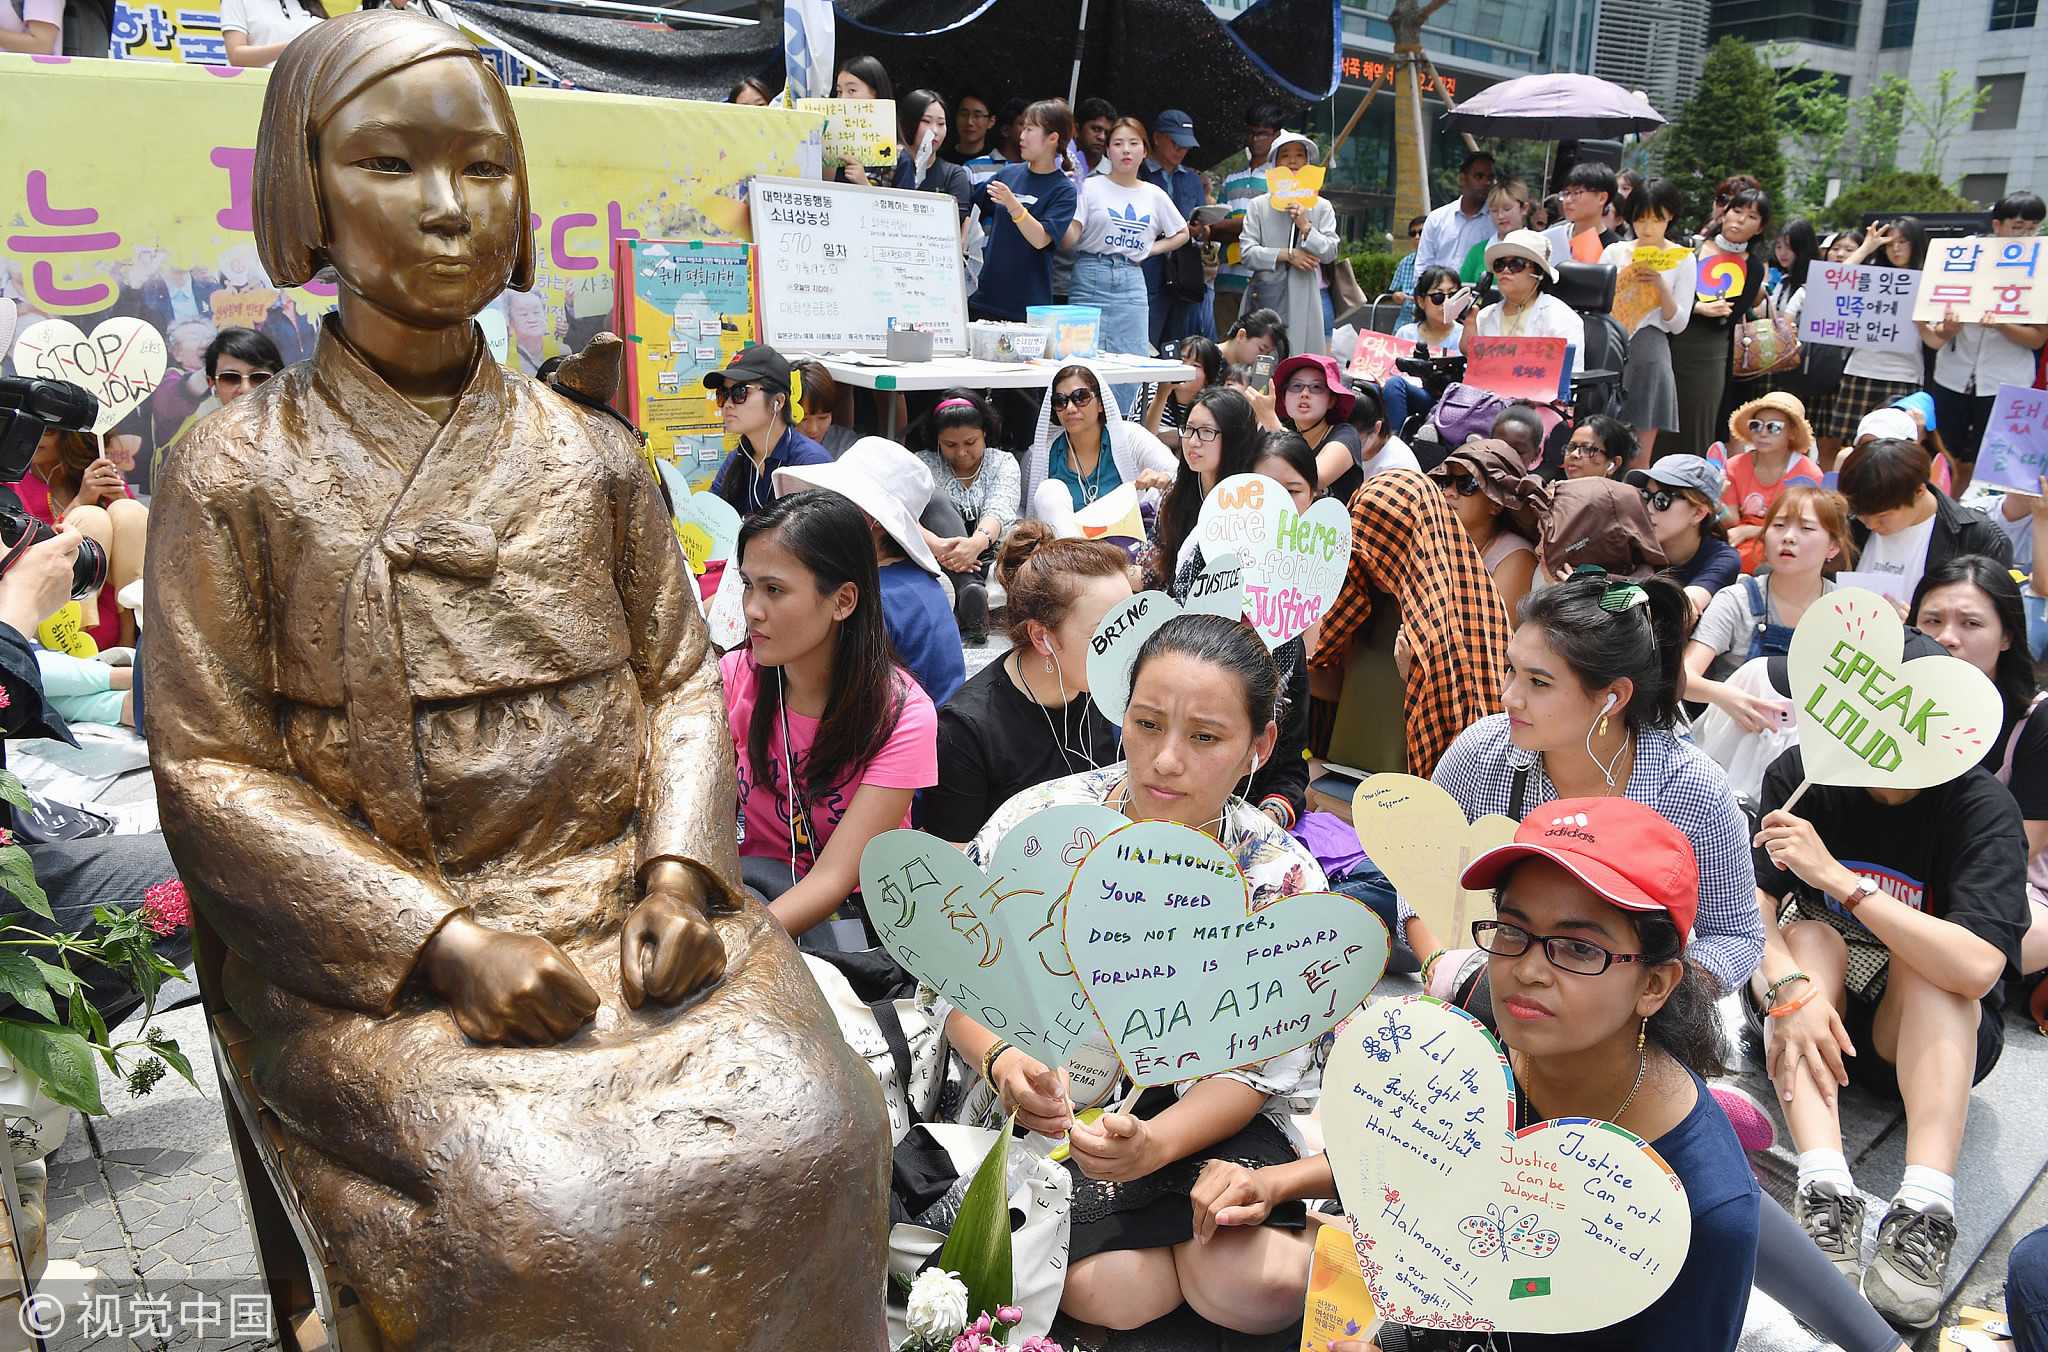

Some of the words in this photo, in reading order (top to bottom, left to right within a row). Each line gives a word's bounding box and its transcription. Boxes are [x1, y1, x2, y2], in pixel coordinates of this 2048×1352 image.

[770, 208, 831, 226] 소녀상농성
[1105, 234, 1145, 251] adidas
[1825, 267, 1873, 292] 역사를
[1879, 271, 1912, 296] 잊은
[1836, 294, 1898, 318] 민족에게
[1810, 319, 1861, 341] 미래란
[1866, 321, 1900, 342] 없다
[36, 334, 122, 381] STOP
[1205, 511, 1267, 544] are
[1276, 508, 1337, 562] Here
[1258, 549, 1308, 586] for
[1091, 597, 1150, 656] BRING
[1193, 567, 1241, 598] JUSTICE
[1823, 640, 1950, 746] SPEAK
[1804, 683, 1903, 772] LOUD
[1544, 827, 1596, 843] adidas
[1164, 892, 1212, 909] SPEED
[1143, 927, 1177, 943] NOT
[1092, 964, 1178, 986] FORWARD
[1202, 960, 1219, 974] IS
[1246, 929, 1339, 966] FORWARD
[1120, 999, 1192, 1045] AJA
[1209, 978, 1284, 1023] AJA
[1068, 1059, 1111, 1079] Yangchi
[1420, 1031, 1456, 1064] Let
[1459, 1067, 1480, 1094] the
[1427, 1075, 1461, 1104] light
[1353, 1083, 1385, 1108] brave
[1390, 1106, 1404, 1118] &
[1411, 1119, 1472, 1158] beautiful
[1383, 1073, 1428, 1114] Justice
[1438, 1119, 1455, 1131] on
[1463, 1128, 1482, 1150] the
[1500, 1145, 1558, 1173] Justice
[1558, 1131, 1633, 1189] Justice
[1516, 1171, 1544, 1186] Can
[1549, 1177, 1566, 1192] be
[1583, 1177, 1616, 1204] Can
[1626, 1203, 1662, 1225] not
[1603, 1213, 1624, 1231] be
[1408, 1265, 1429, 1281] our
